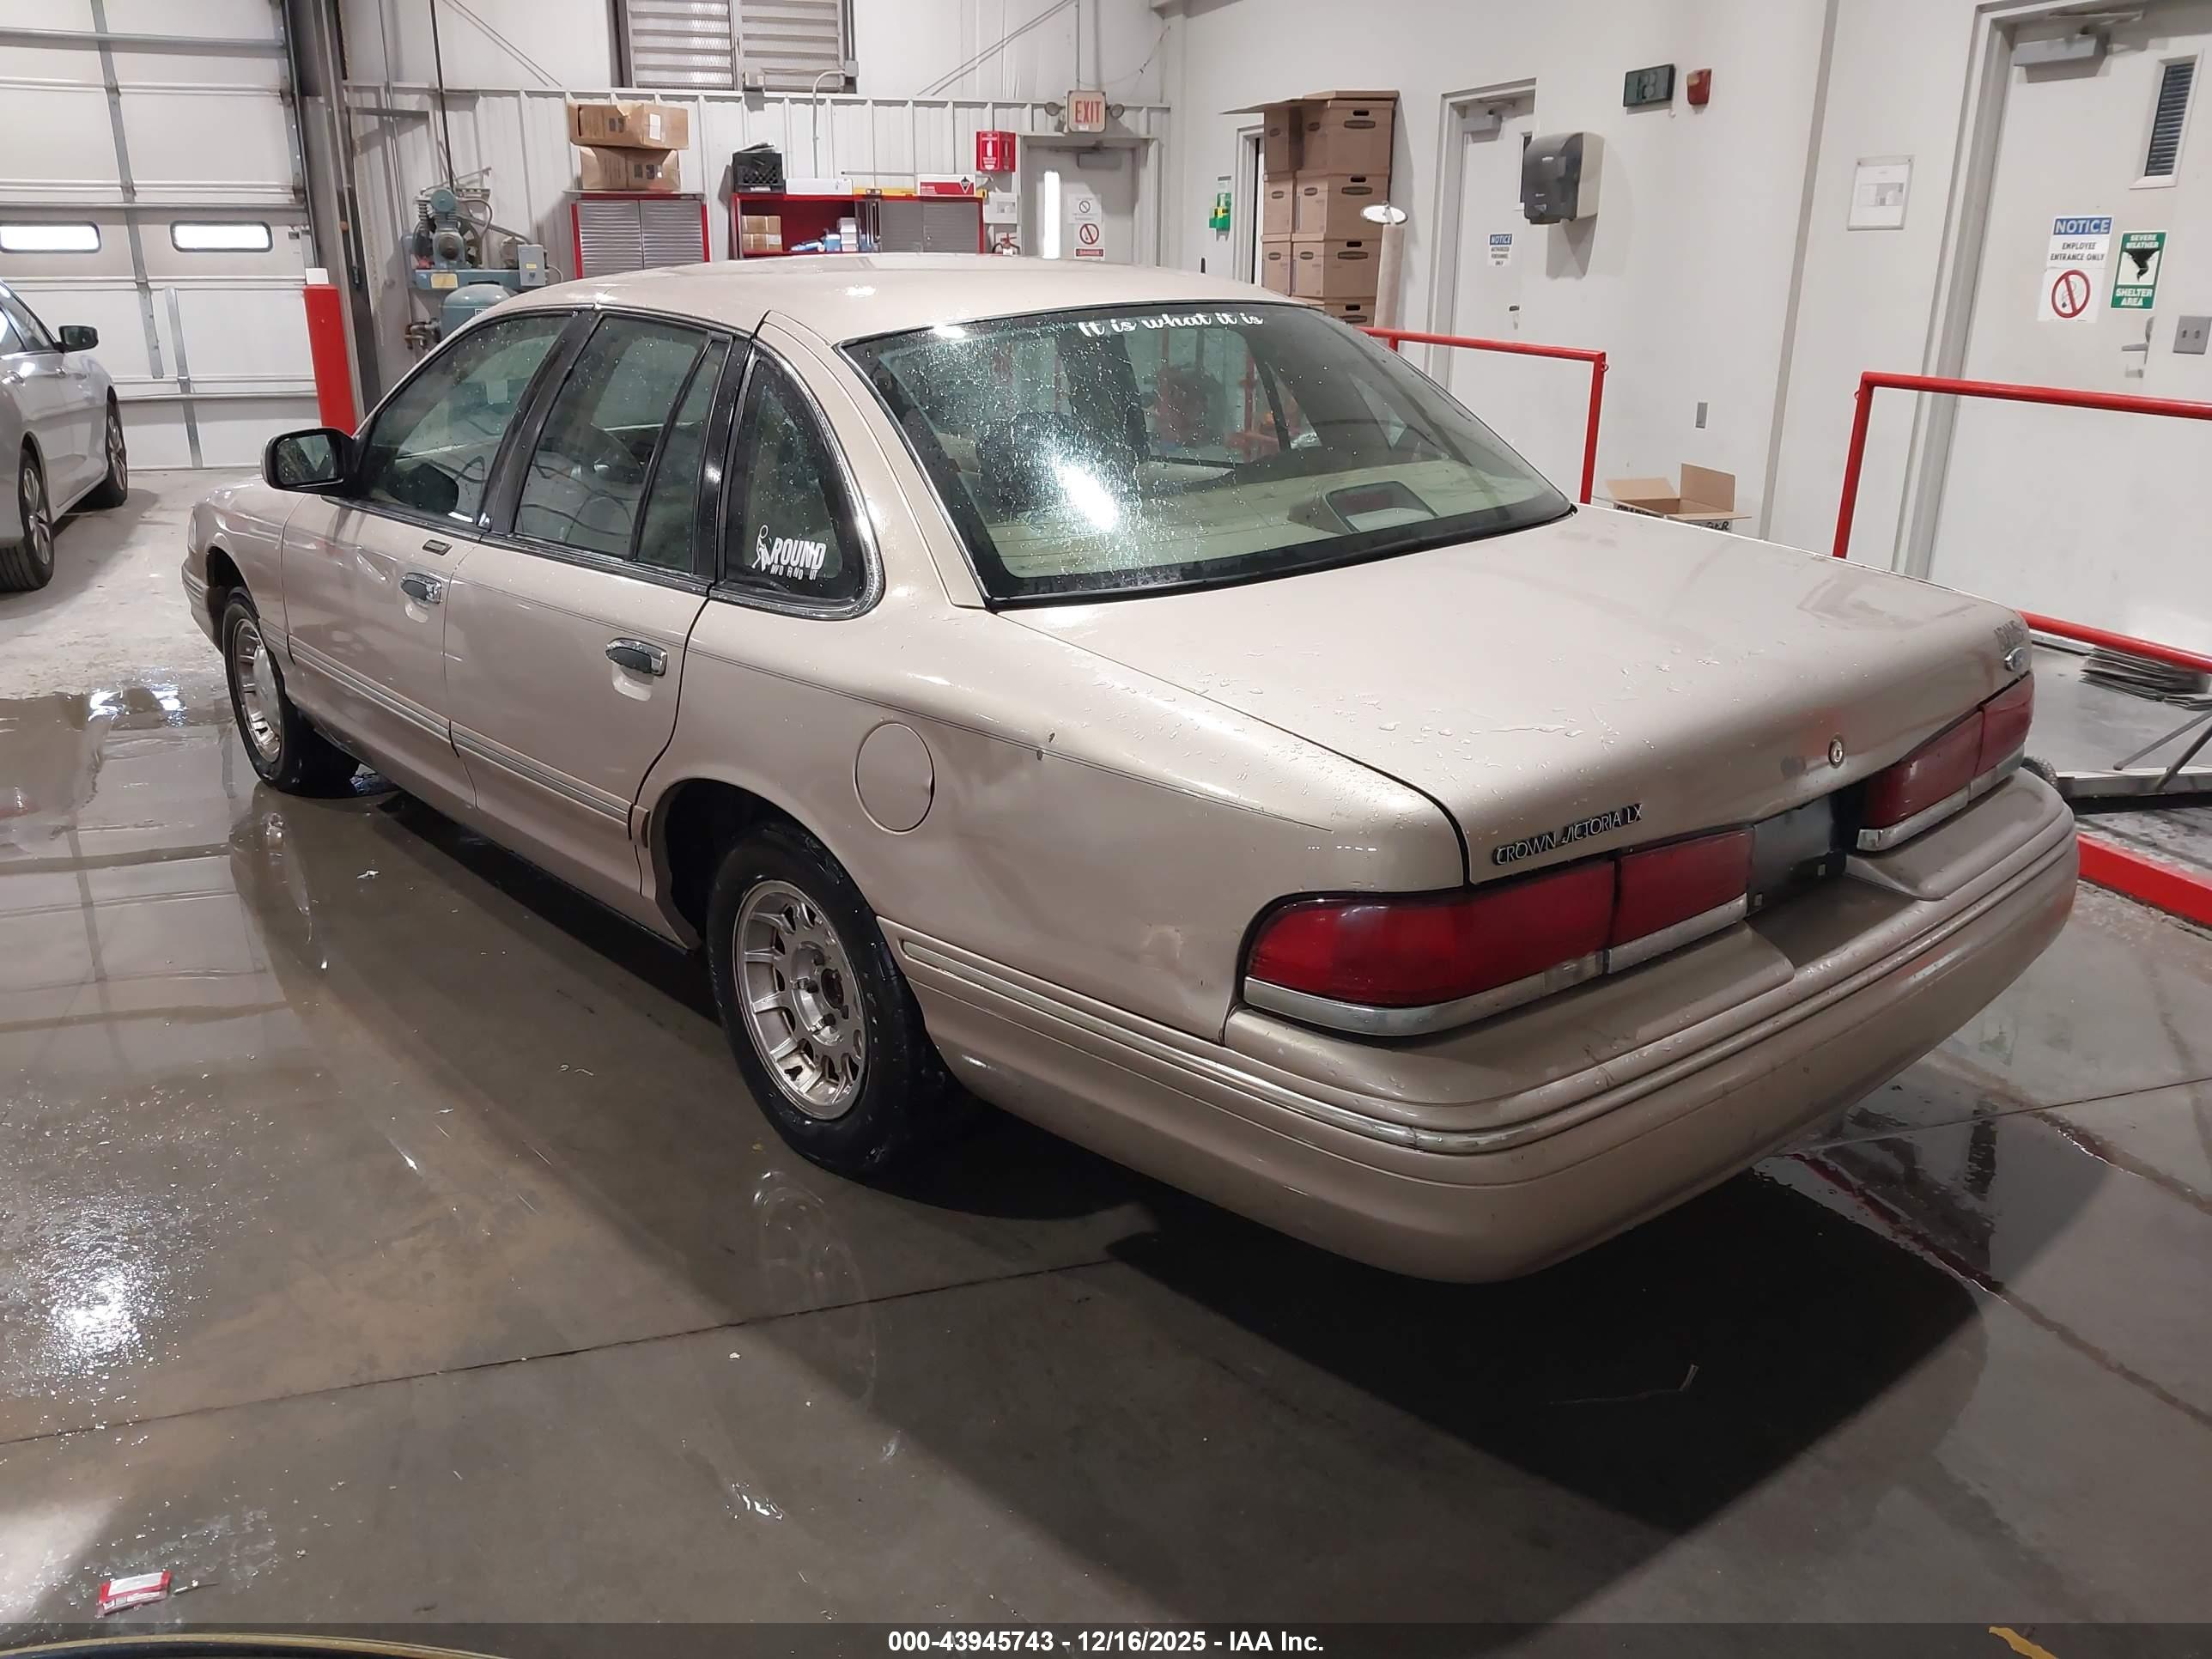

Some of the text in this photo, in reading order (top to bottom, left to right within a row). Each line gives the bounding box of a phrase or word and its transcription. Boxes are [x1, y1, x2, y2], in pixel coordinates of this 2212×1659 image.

[1075, 100, 1102, 123] EXIT
[2056, 219, 2110, 234] NOTICE
[1491, 235, 1511, 244] NOTICE
[2116, 289, 2153, 297] SHELTER
[1079, 313, 1264, 337] It is what it is
[1495, 803, 1643, 865] CROWN VICTORIA LX
